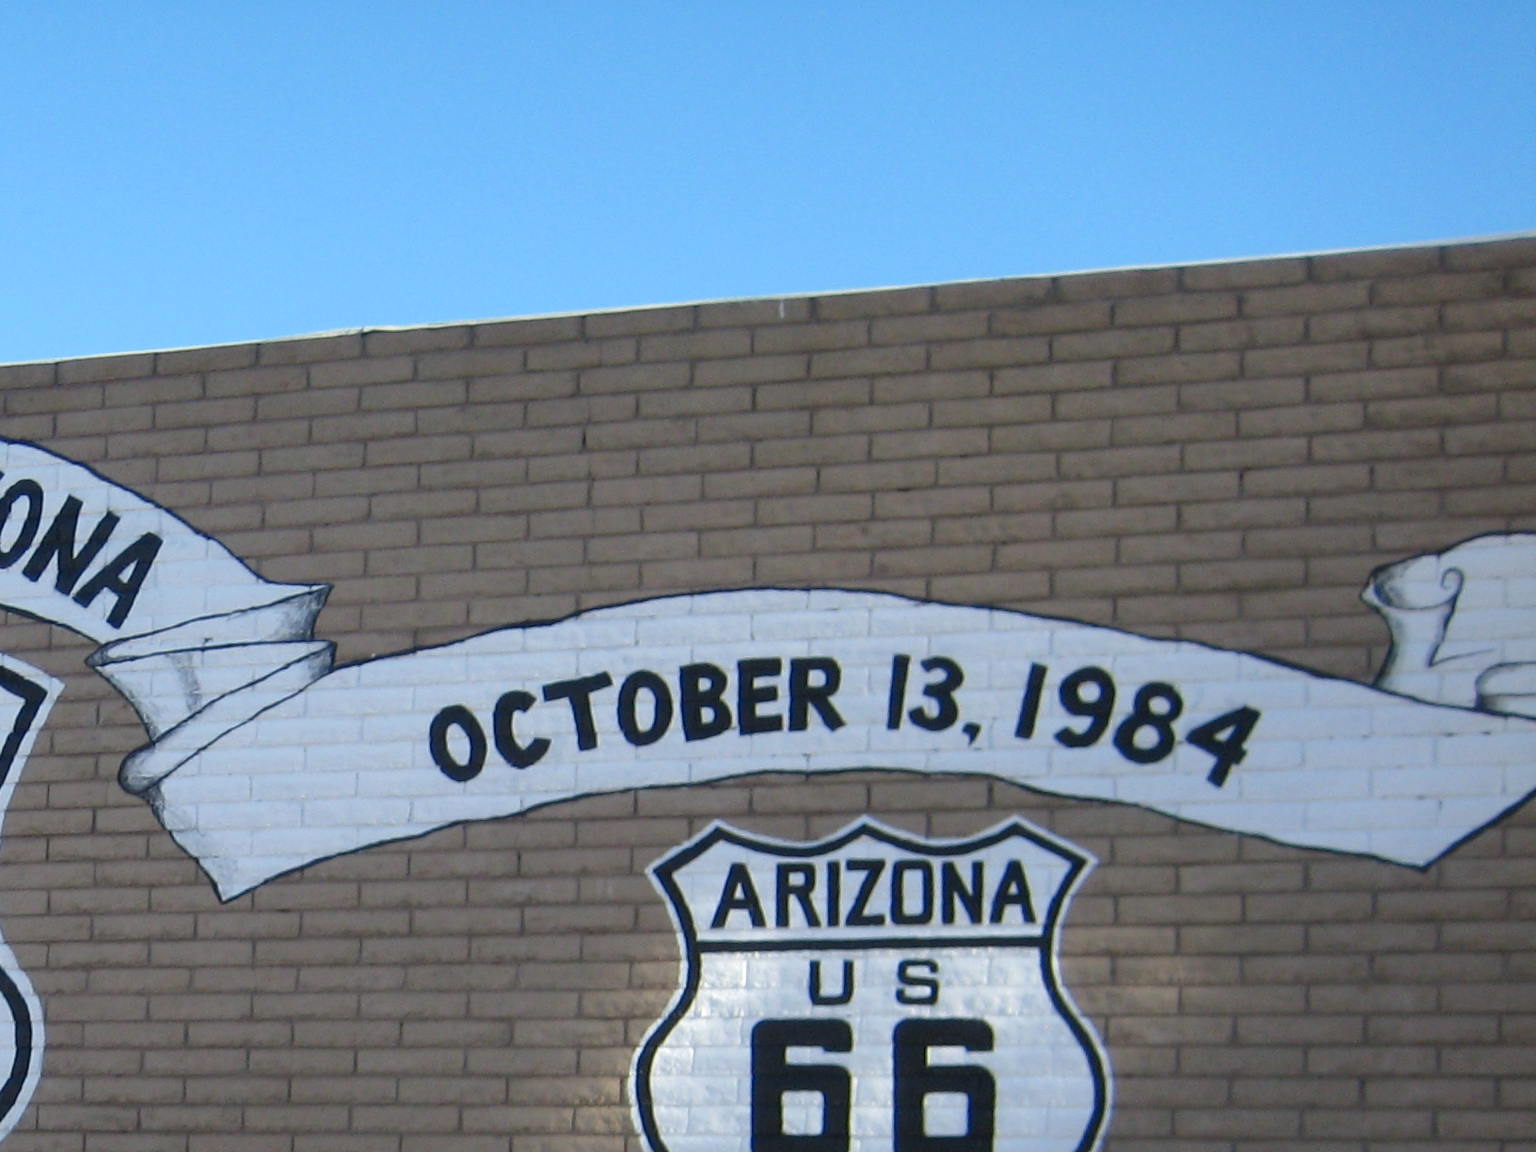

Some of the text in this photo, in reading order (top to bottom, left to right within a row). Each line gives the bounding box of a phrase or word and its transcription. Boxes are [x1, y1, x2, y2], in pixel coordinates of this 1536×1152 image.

[429, 654, 1261, 788] OCTOBER 13, 1984
[710, 860, 1037, 928] ARIZONA
